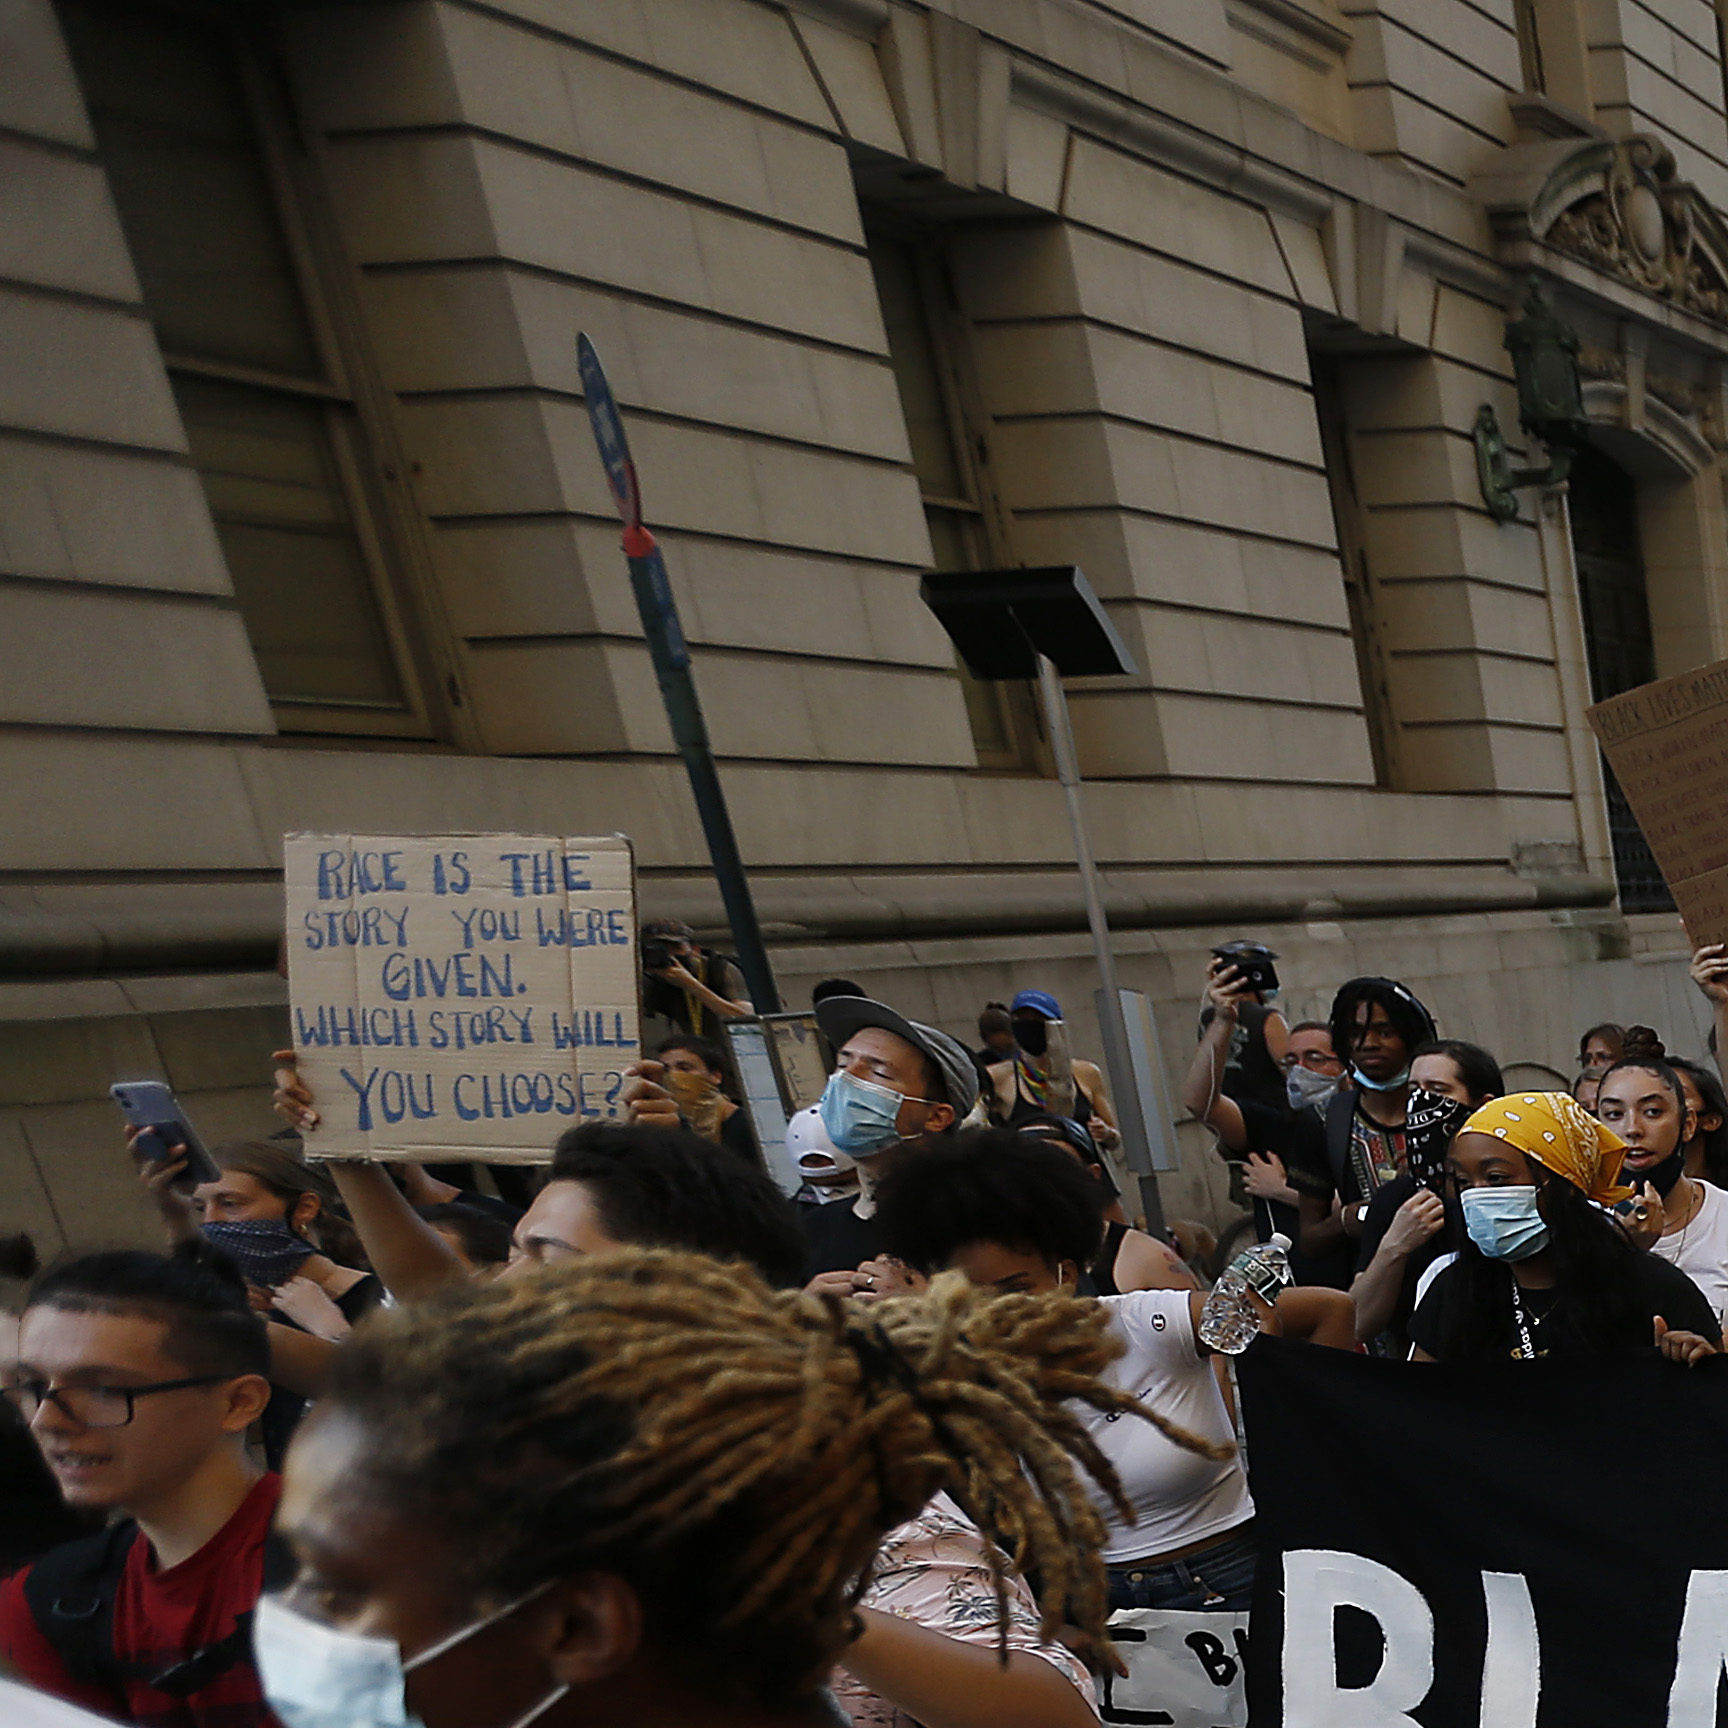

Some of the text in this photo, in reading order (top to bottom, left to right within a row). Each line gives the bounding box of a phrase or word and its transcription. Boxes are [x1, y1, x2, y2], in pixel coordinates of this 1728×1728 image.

[1597, 701, 1647, 739] BLACK
[1647, 686, 1692, 721] LIVES
[318, 850, 592, 900] RACE IS THE
[305, 906, 629, 950] STORY YOU WERE
[382, 952, 528, 1001] GIVEN.
[296, 1004, 638, 1050] WHICH STORY WILL
[340, 1066, 624, 1131] YOU CHOOSE?
